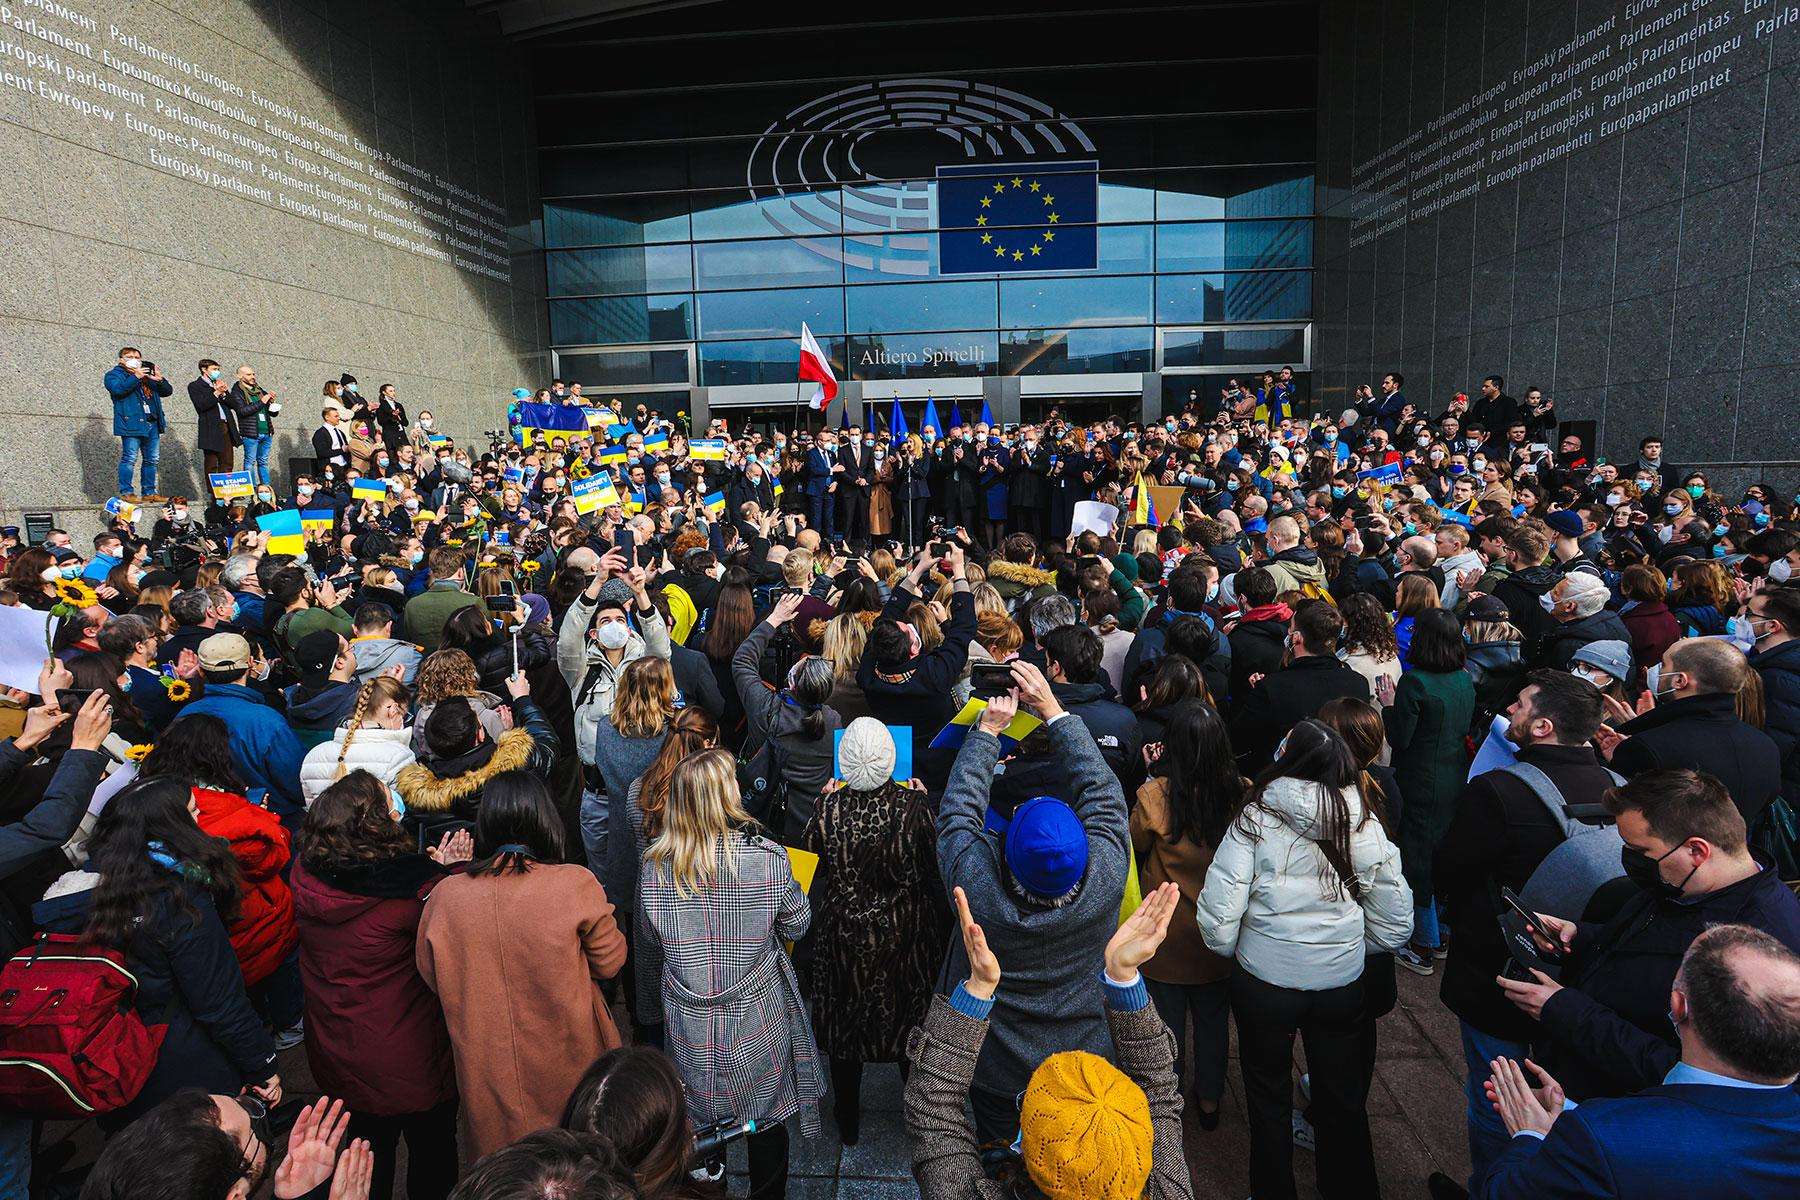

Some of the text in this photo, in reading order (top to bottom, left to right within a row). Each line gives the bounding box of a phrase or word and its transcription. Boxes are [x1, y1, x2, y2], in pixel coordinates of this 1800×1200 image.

[1, 6, 93, 59] Parlament
[103, 49, 180, 96] Ευρωπαϊκό
[184, 84, 257, 128] Κοινοβούλιο
[265, 119, 313, 151] European
[314, 141, 364, 173] Parliament
[368, 164, 409, 192] Parlement
[409, 184, 442, 206] européen
[110, 24, 191, 74] Parlamento
[194, 63, 243, 98] Europeo
[251, 90, 298, 124] Evropský
[300, 115, 350, 146] parlament
[354, 137, 432, 183] Europa-Parlamentet
[1410, 154, 1450, 182] Parlamento
[1451, 137, 1485, 161] europeo
[1490, 117, 1523, 142] Eiropas
[1525, 86, 1583, 124] Parlaments
[1590, 56, 1638, 92] Europos
[1641, 9, 1730, 65] Parlamentas
[1412, 179, 1443, 201] Europees
[1444, 157, 1486, 186] Parlement
[1490, 130, 1538, 163] Parlament
[1540, 102, 1595, 141] Europejski
[1602, 66, 1676, 111] Parlamento
[1680, 34, 1742, 75] Europeu
[1427, 102, 1470, 133] Parlamento
[1471, 80, 1507, 109] Europeo
[1513, 49, 1557, 85] Evropský
[1558, 14, 1616, 62] parlament
[1504, 80, 1549, 113] European
[1550, 44, 1611, 87] Parliament
[1620, 2, 1689, 50] Parlement
[0, 71, 35, 95] ent
[39, 80, 114, 121] Ewropew
[125, 112, 189, 149] Europees
[191, 137, 255, 173] Parlement
[261, 163, 314, 195] Parlament
[315, 184, 362, 213] Europejski
[367, 203, 412, 230] Parlamento
[412, 220, 442, 241] Europeu
[65, 65, 146, 108] parlament
[155, 98, 230, 140] Parlamento
[232, 132, 278, 159] europeo
[285, 150, 321, 176] Eiropas
[323, 165, 372, 196] Parlaments
[377, 187, 409, 210] Europos
[150, 147, 209, 184] Európsky
[212, 173, 272, 202] parlament
[279, 192, 321, 219] Evropski
[322, 211, 368, 235] parlament
[373, 226, 411, 249] Euroopan
[1410, 197, 1440, 221] Evropski
[1440, 180, 1481, 210] parlament
[1486, 160, 1528, 188] Euroopan
[1530, 129, 1593, 171] parlamentti
[1600, 67, 1732, 138] Europaparlamentet
[860, 345, 985, 366] Altiero Spinelli
